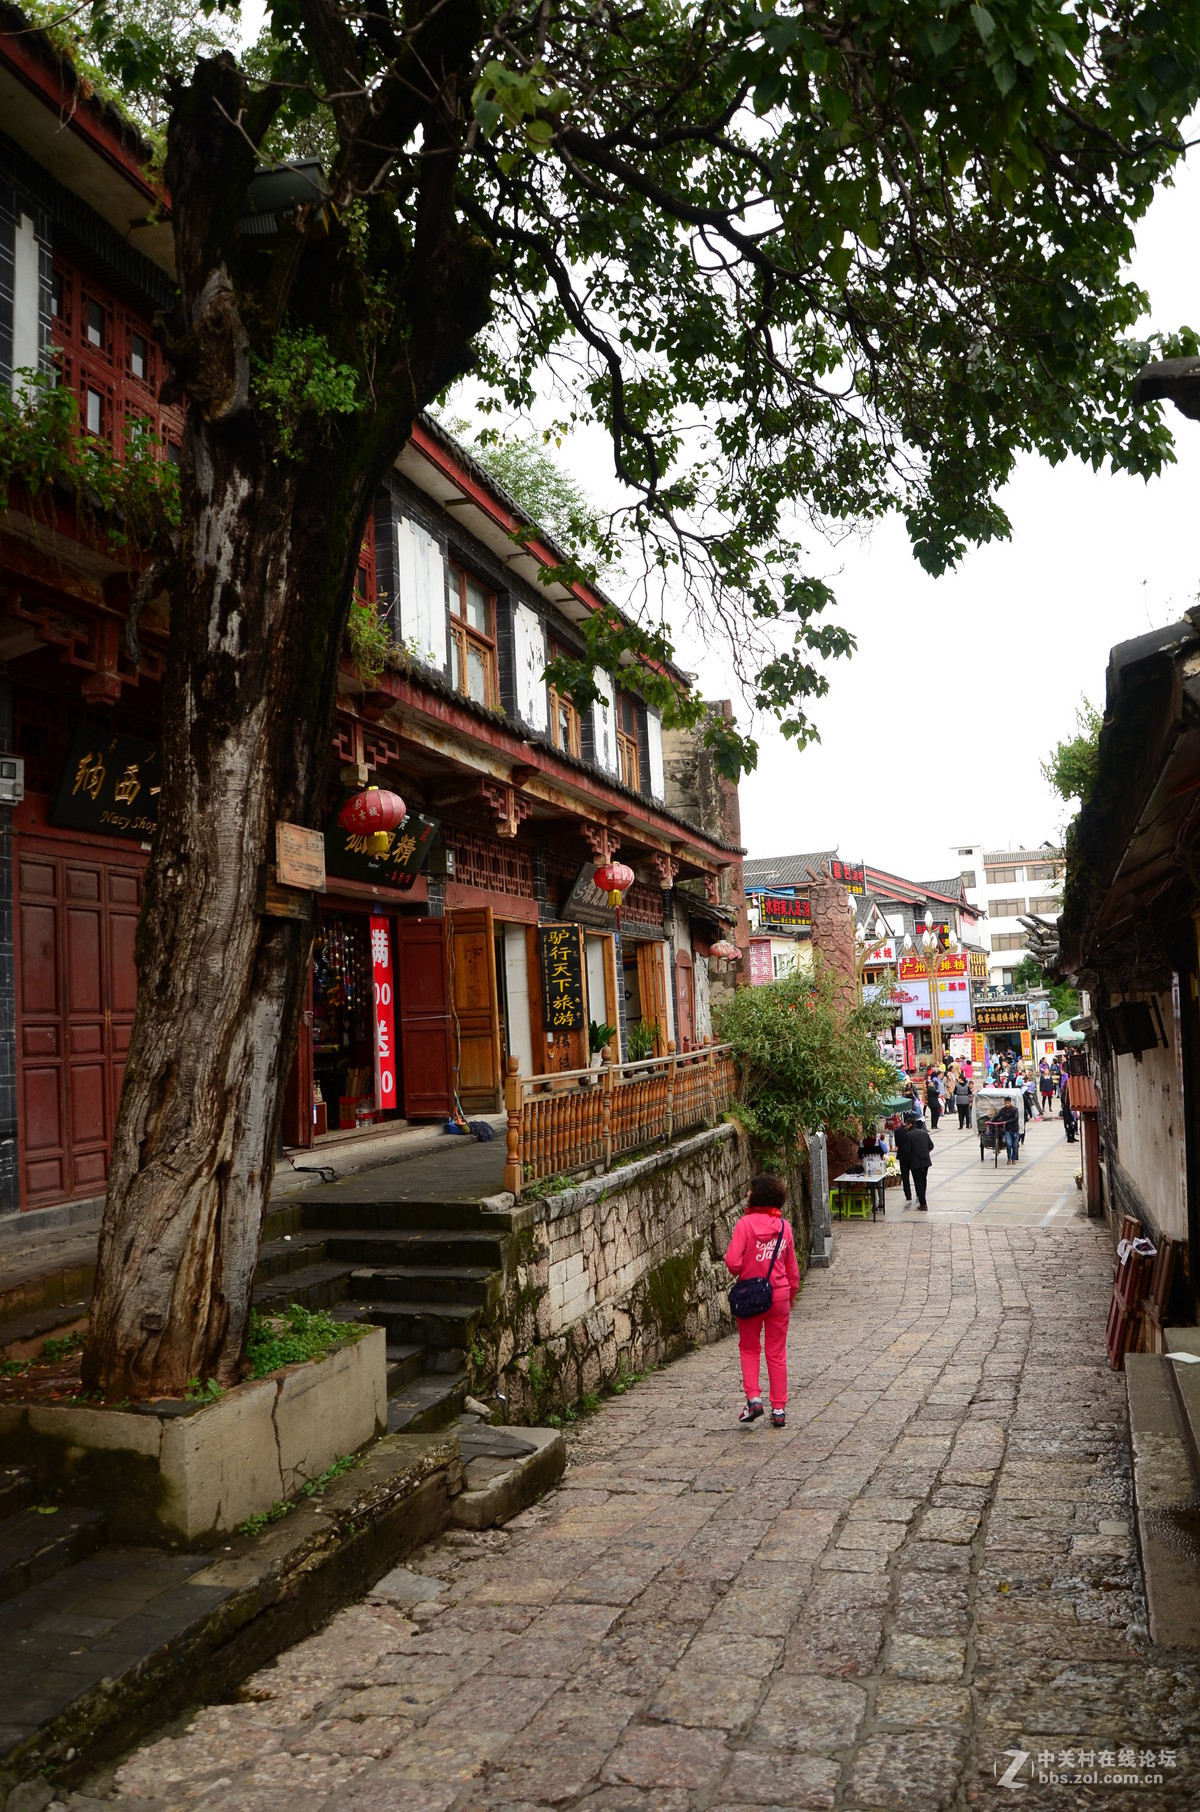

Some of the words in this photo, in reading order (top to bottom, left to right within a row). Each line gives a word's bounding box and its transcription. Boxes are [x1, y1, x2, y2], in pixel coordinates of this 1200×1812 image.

[130, 816, 158, 835] Shop
[901, 959, 965, 974] 广州排档
[548, 929, 576, 1026] 驴行天下旅游
